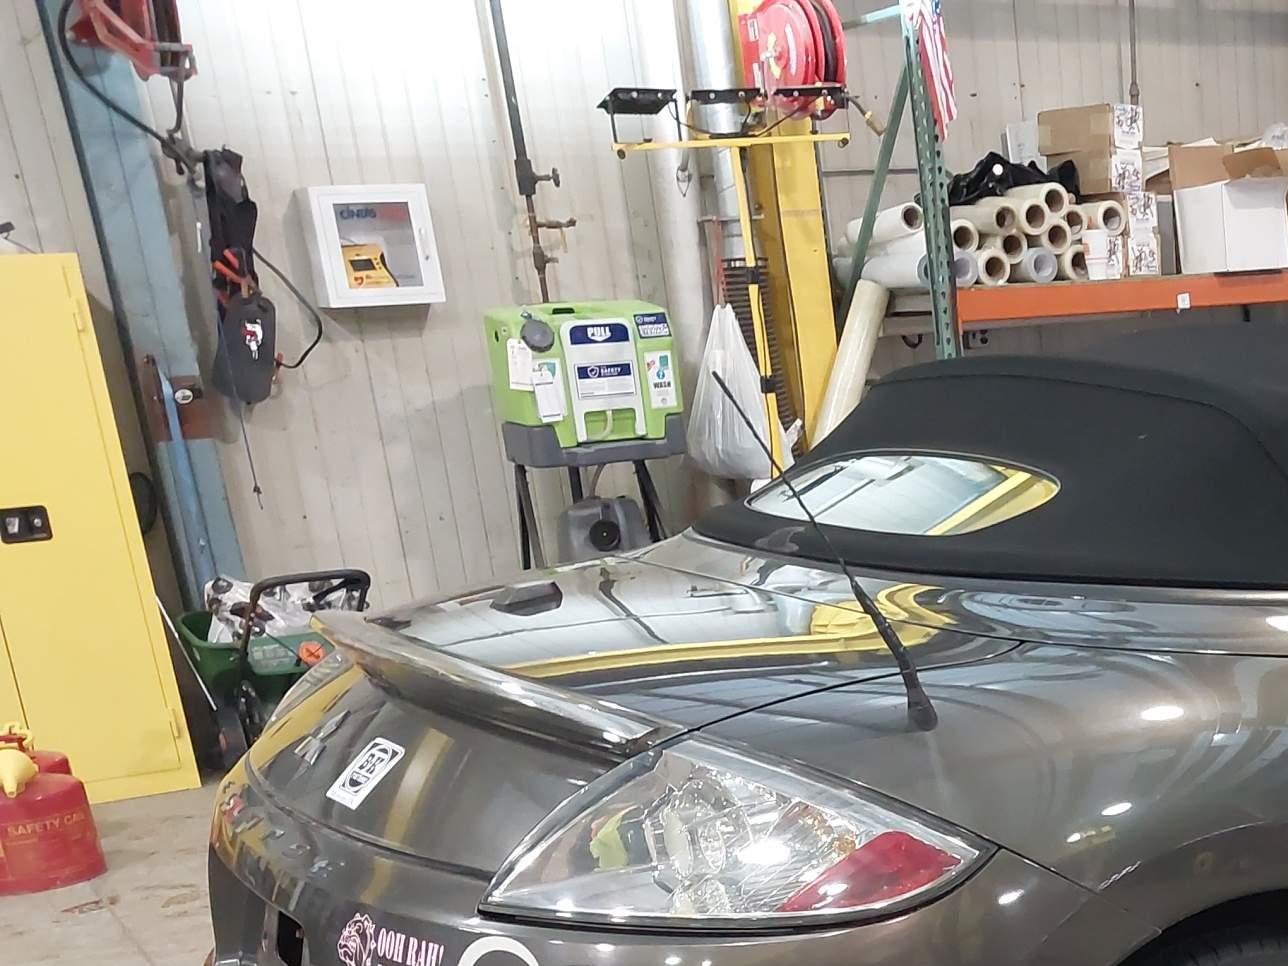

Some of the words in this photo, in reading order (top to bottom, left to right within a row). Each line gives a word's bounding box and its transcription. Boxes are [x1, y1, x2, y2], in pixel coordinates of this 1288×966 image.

[586, 326, 611, 337] PULL
[653, 381, 671, 389] WASH
[7, 817, 60, 836] SAFETY
[377, 927, 406, 964] OOH
